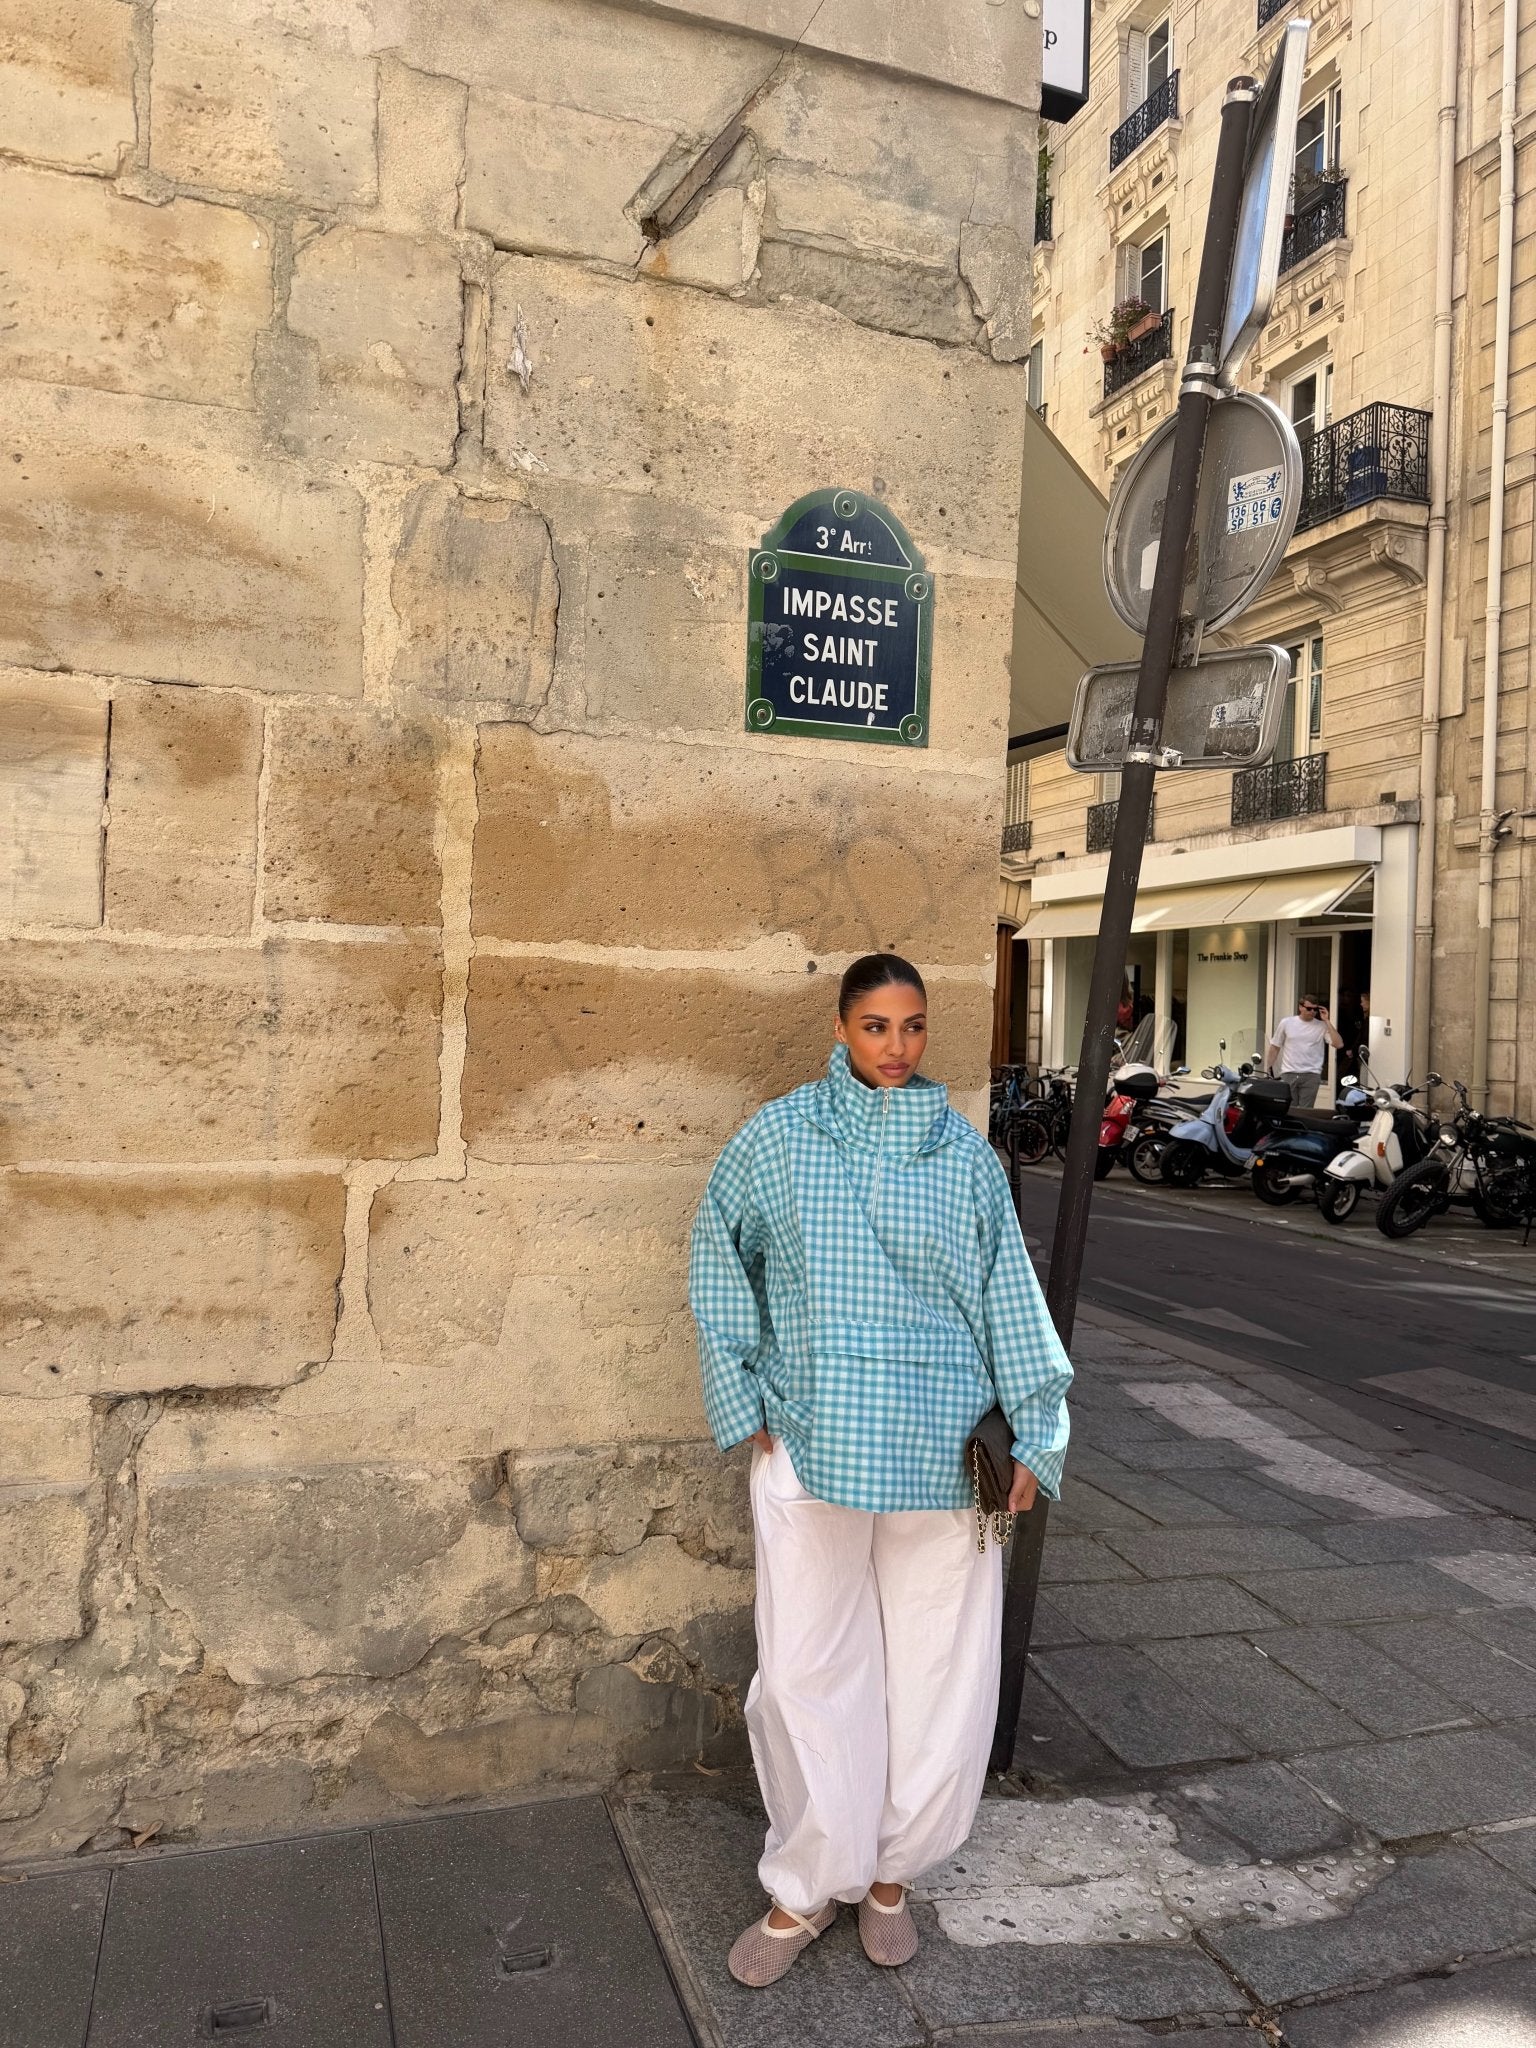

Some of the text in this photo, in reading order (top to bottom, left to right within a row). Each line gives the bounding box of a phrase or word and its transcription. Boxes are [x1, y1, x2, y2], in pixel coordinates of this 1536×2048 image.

[1230, 499, 1267, 519] 136 06
[1231, 512, 1264, 531] SP 51
[783, 586, 899, 628] IMPASSE
[803, 633, 878, 667] SAINT
[789, 675, 889, 711] CLAUDE
[1197, 953, 1209, 961] The
[1233, 951, 1248, 962] Shop
